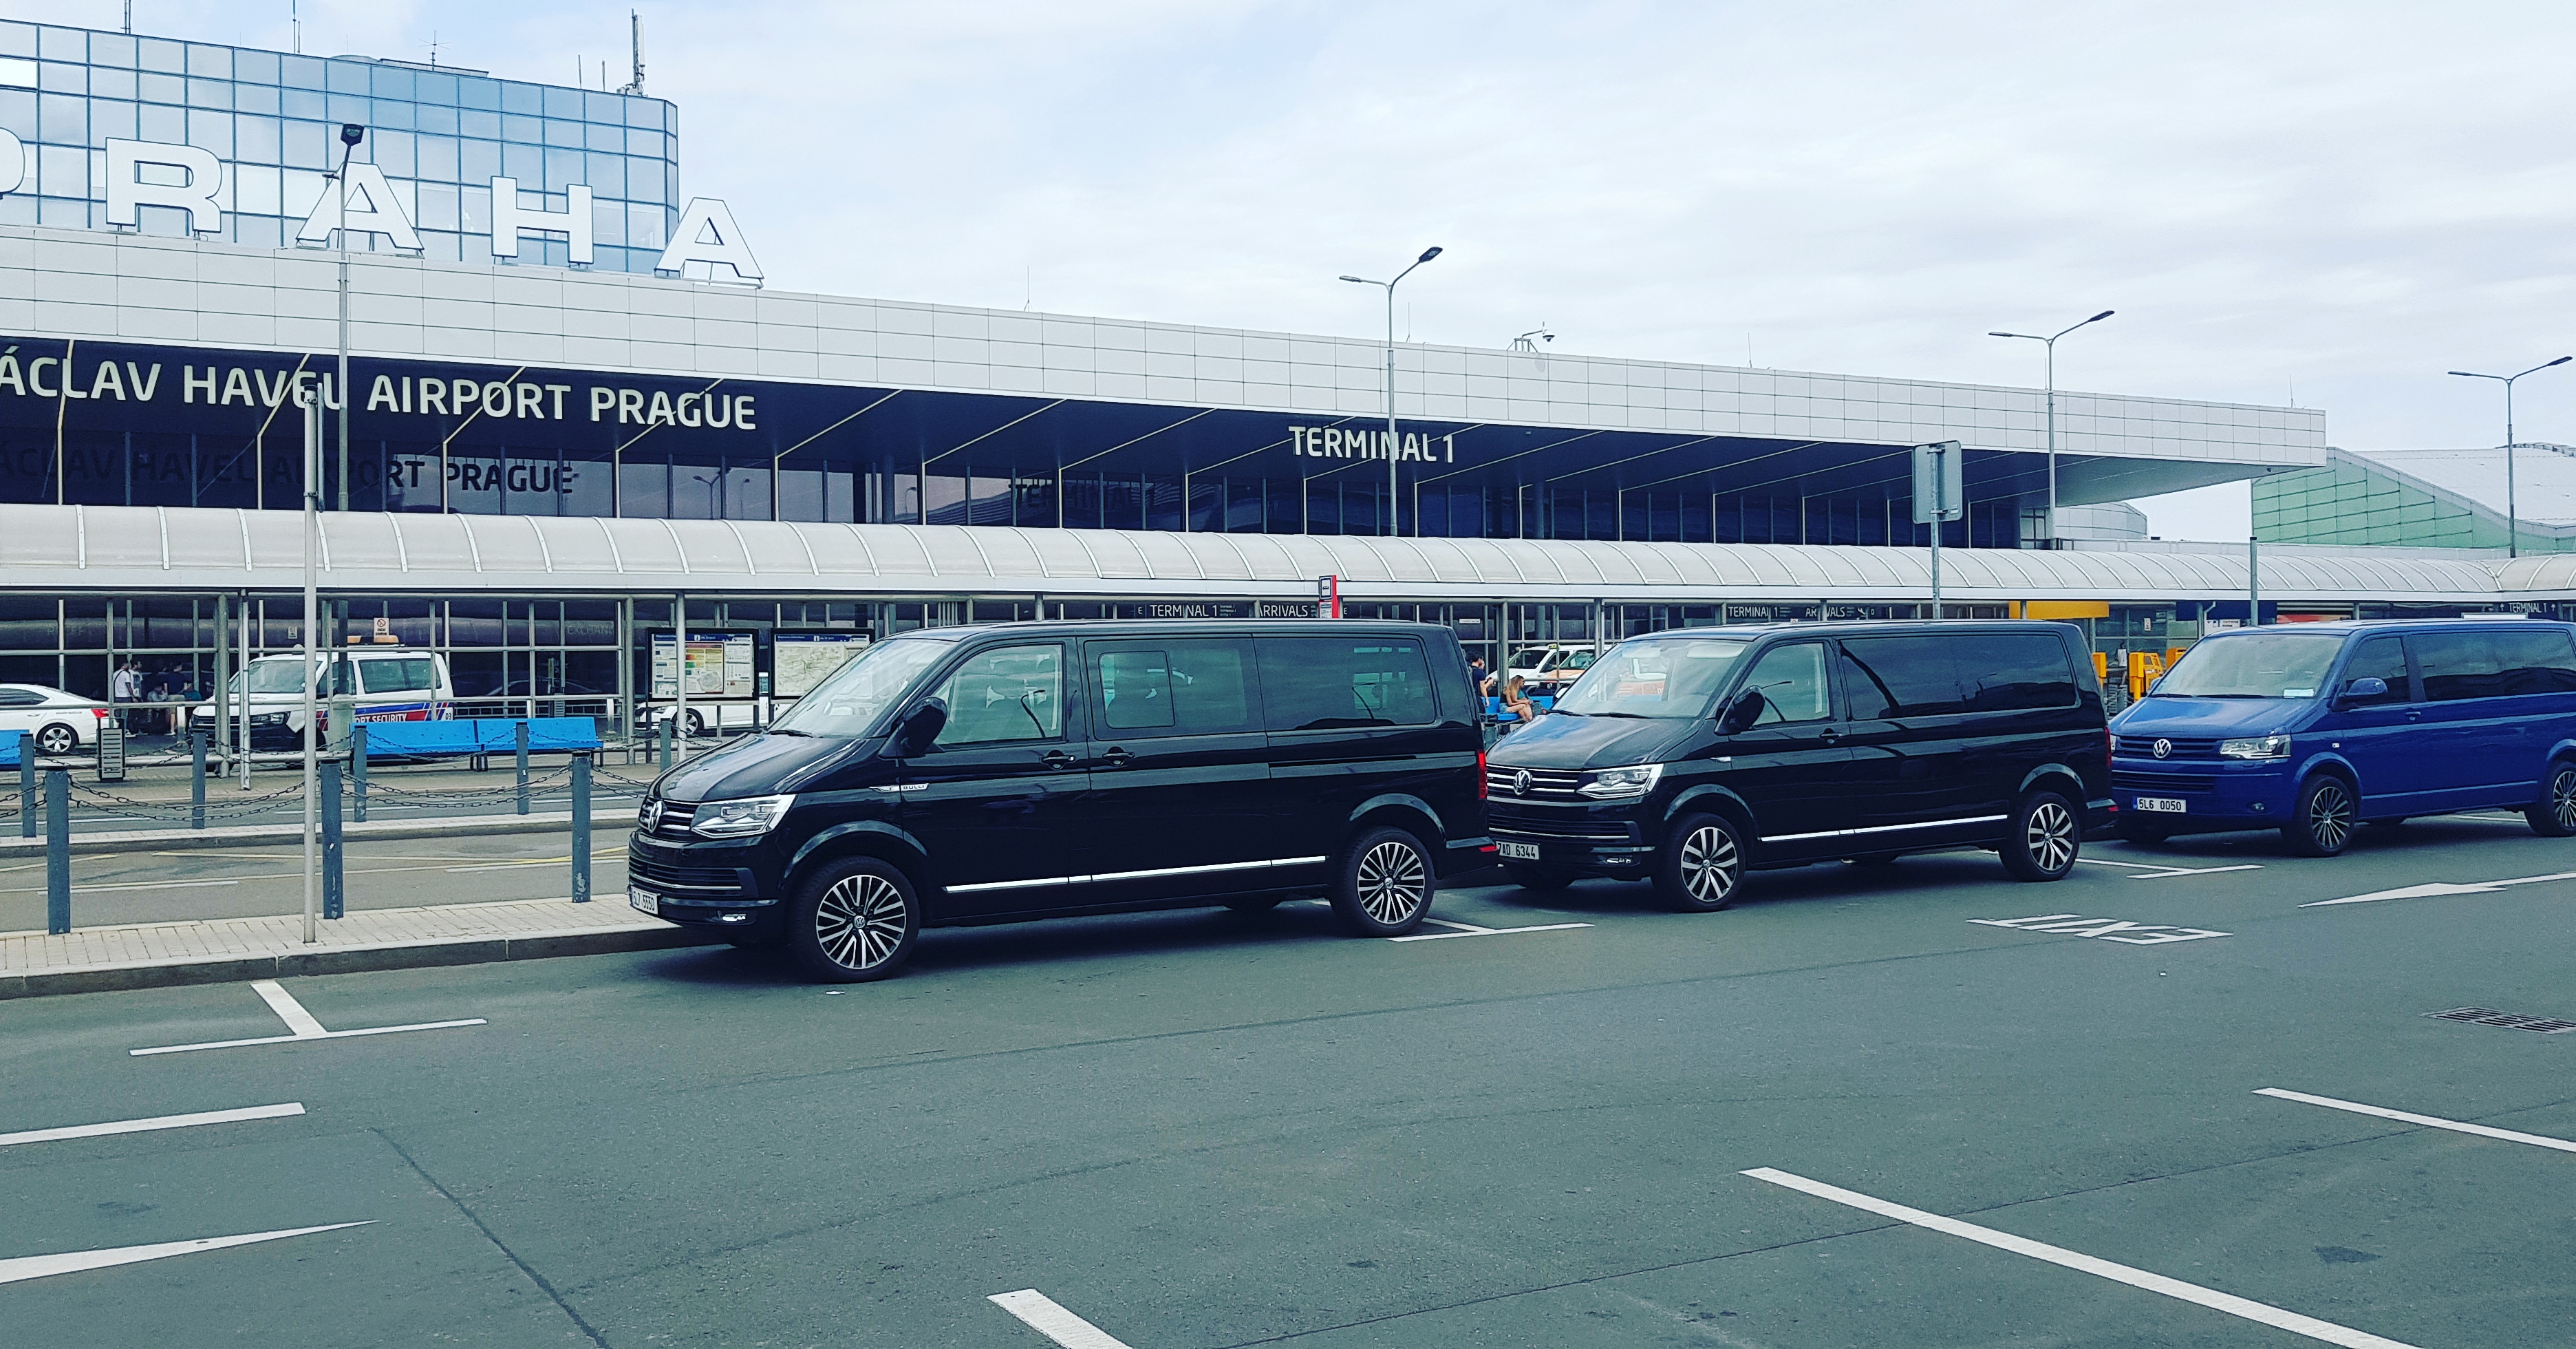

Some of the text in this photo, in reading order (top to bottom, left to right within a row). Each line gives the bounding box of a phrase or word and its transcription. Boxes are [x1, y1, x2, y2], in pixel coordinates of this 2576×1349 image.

[0, 127, 764, 279] RAHA
[184, 365, 341, 410] HAVEL
[367, 374, 571, 421] AIRPORT
[590, 386, 756, 430] PRAGUE
[1288, 426, 1453, 463] TERMINAL 1
[1212, 604, 1217, 617] 1
[1805, 606, 1845, 617] ARVALS
[372, 713, 407, 723] SECURITY
[2138, 798, 2182, 811] 5L6 0050
[1497, 842, 1536, 858] 7AD 6344
